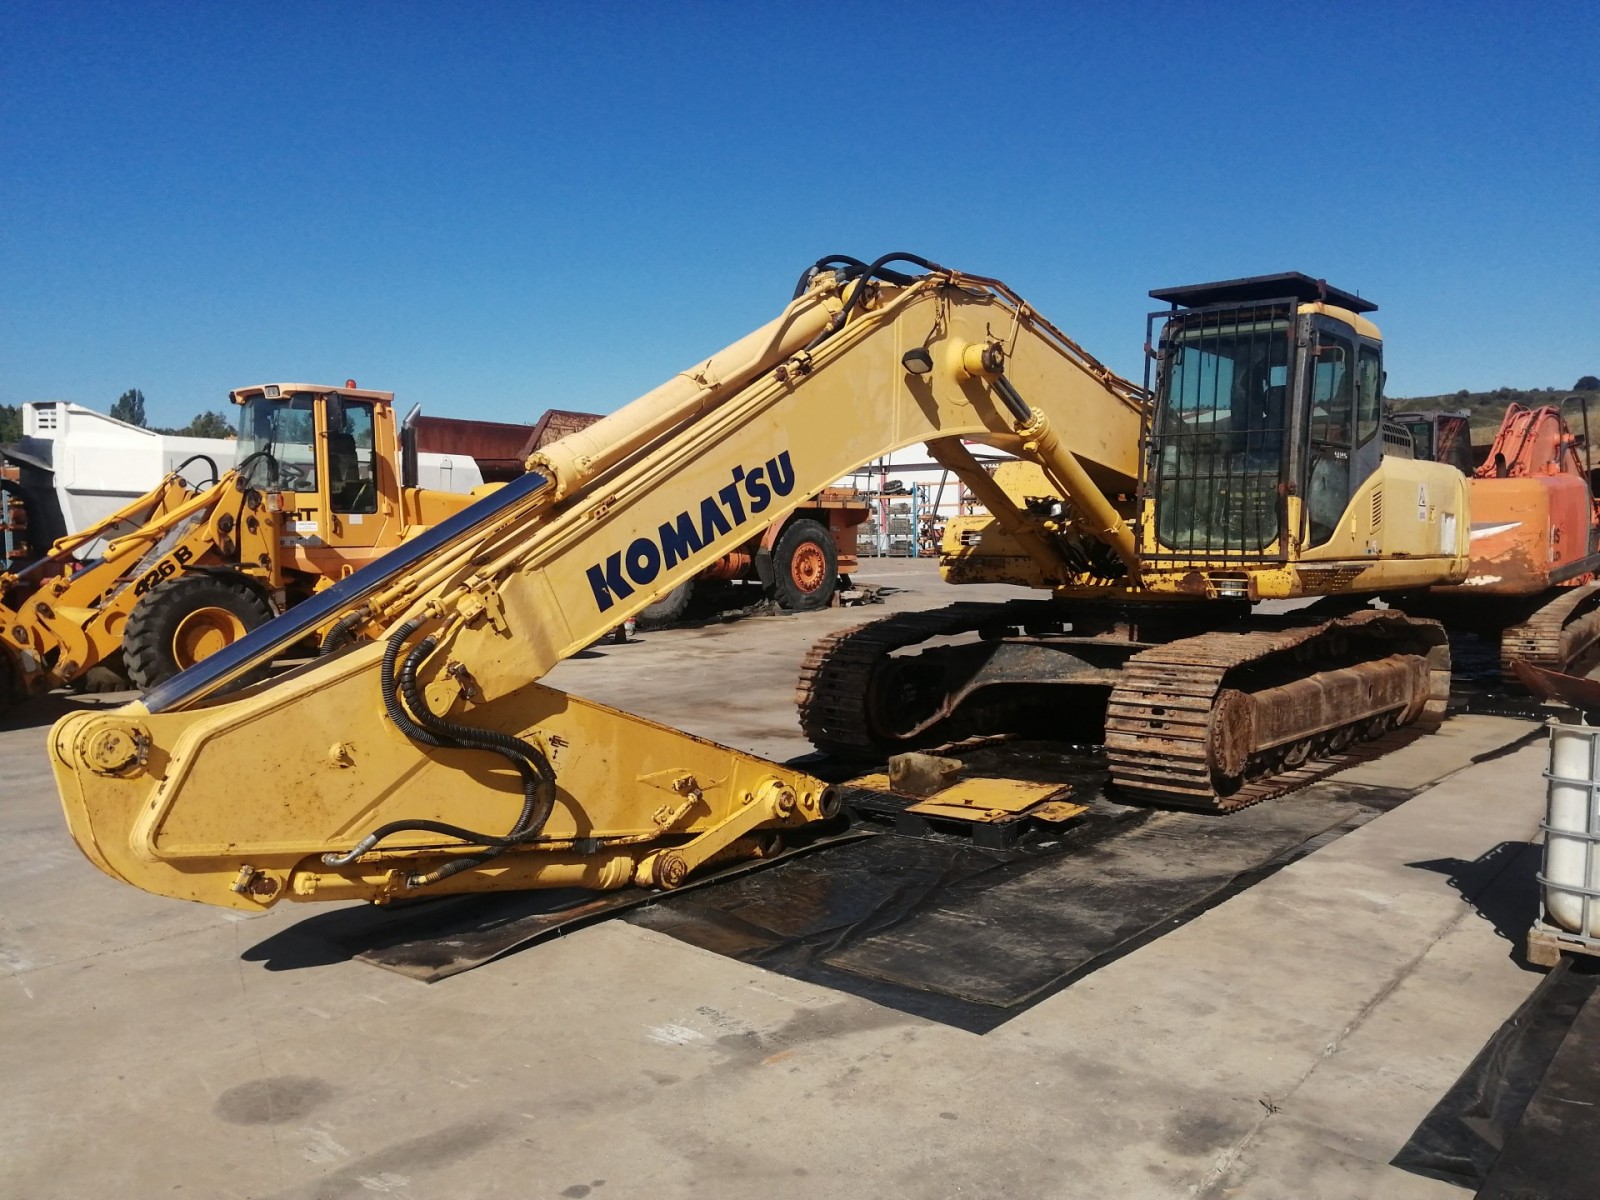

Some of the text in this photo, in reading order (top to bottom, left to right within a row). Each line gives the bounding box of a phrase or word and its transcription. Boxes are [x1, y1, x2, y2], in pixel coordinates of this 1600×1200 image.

[134, 545, 193, 598] 426 B
[585, 450, 795, 613] KOMATSU
